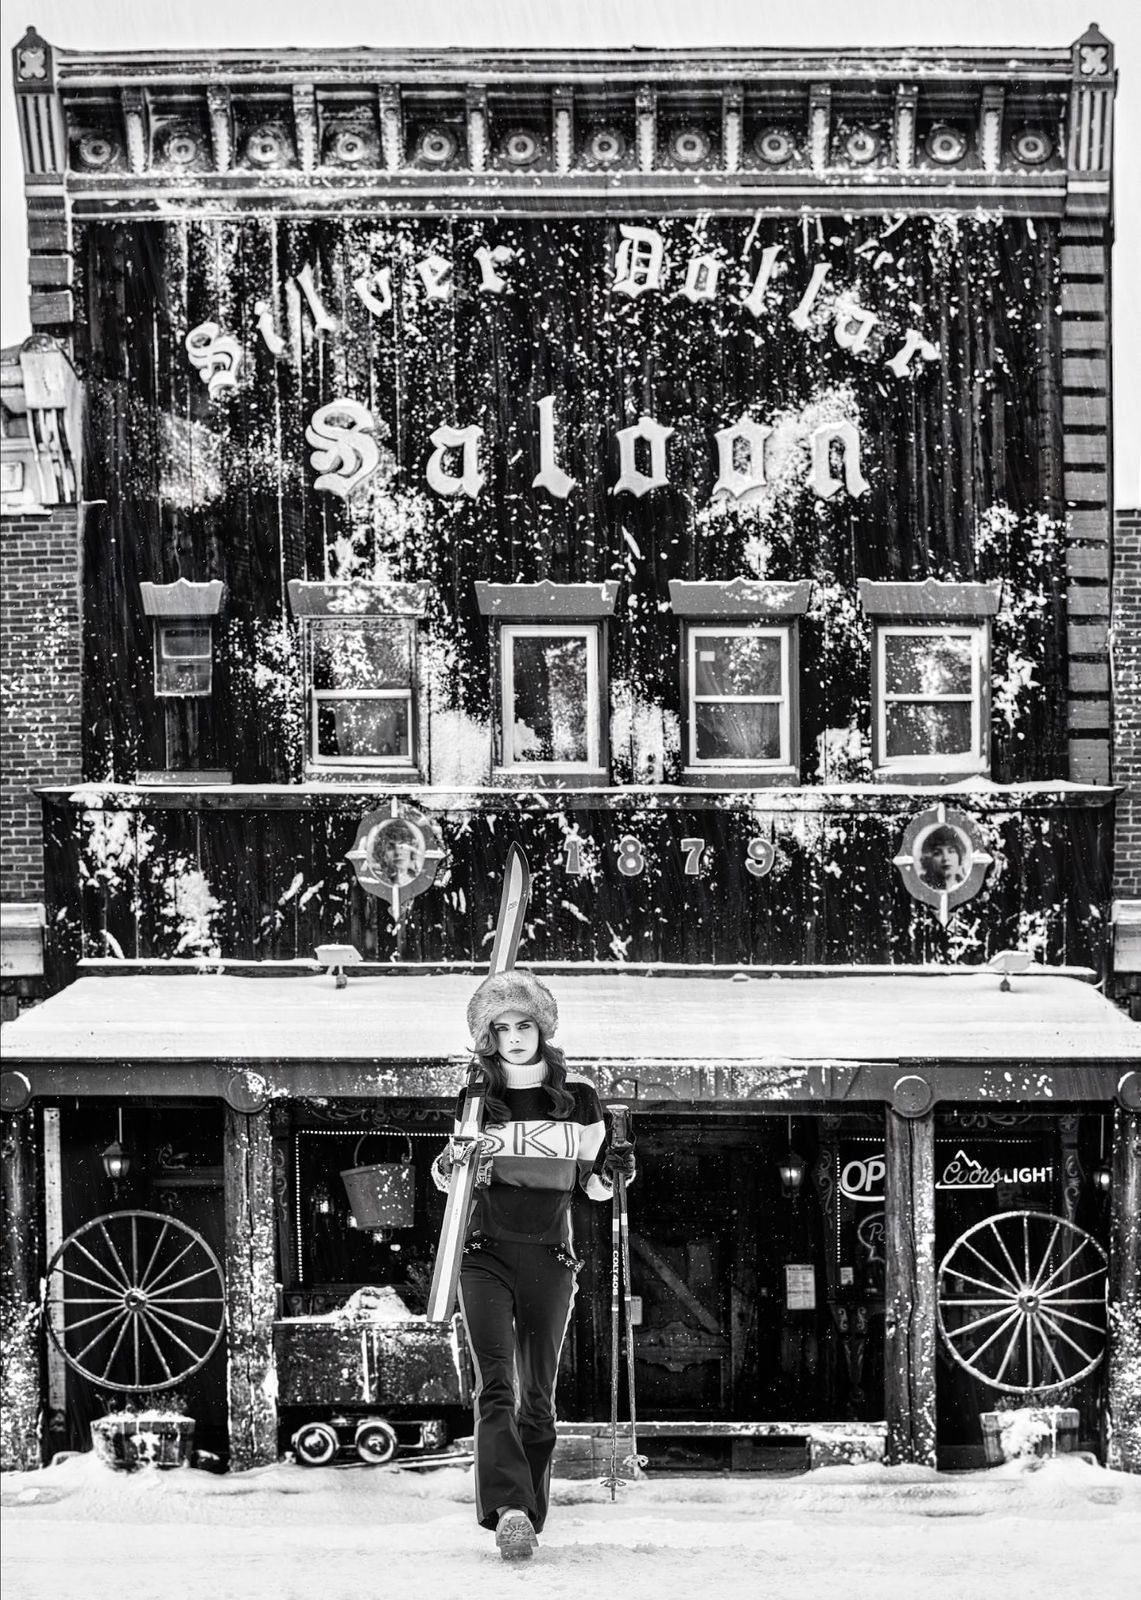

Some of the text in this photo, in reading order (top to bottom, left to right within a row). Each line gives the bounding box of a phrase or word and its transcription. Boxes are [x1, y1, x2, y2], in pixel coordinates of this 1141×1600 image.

[185, 224, 942, 399] Silver Dollar
[305, 396, 870, 499] Saloon
[564, 837, 775, 877] 1879
[480, 1121, 575, 1158] SKI
[841, 1161, 885, 1192] OP
[943, 1161, 1053, 1184] Coors LIGHT
